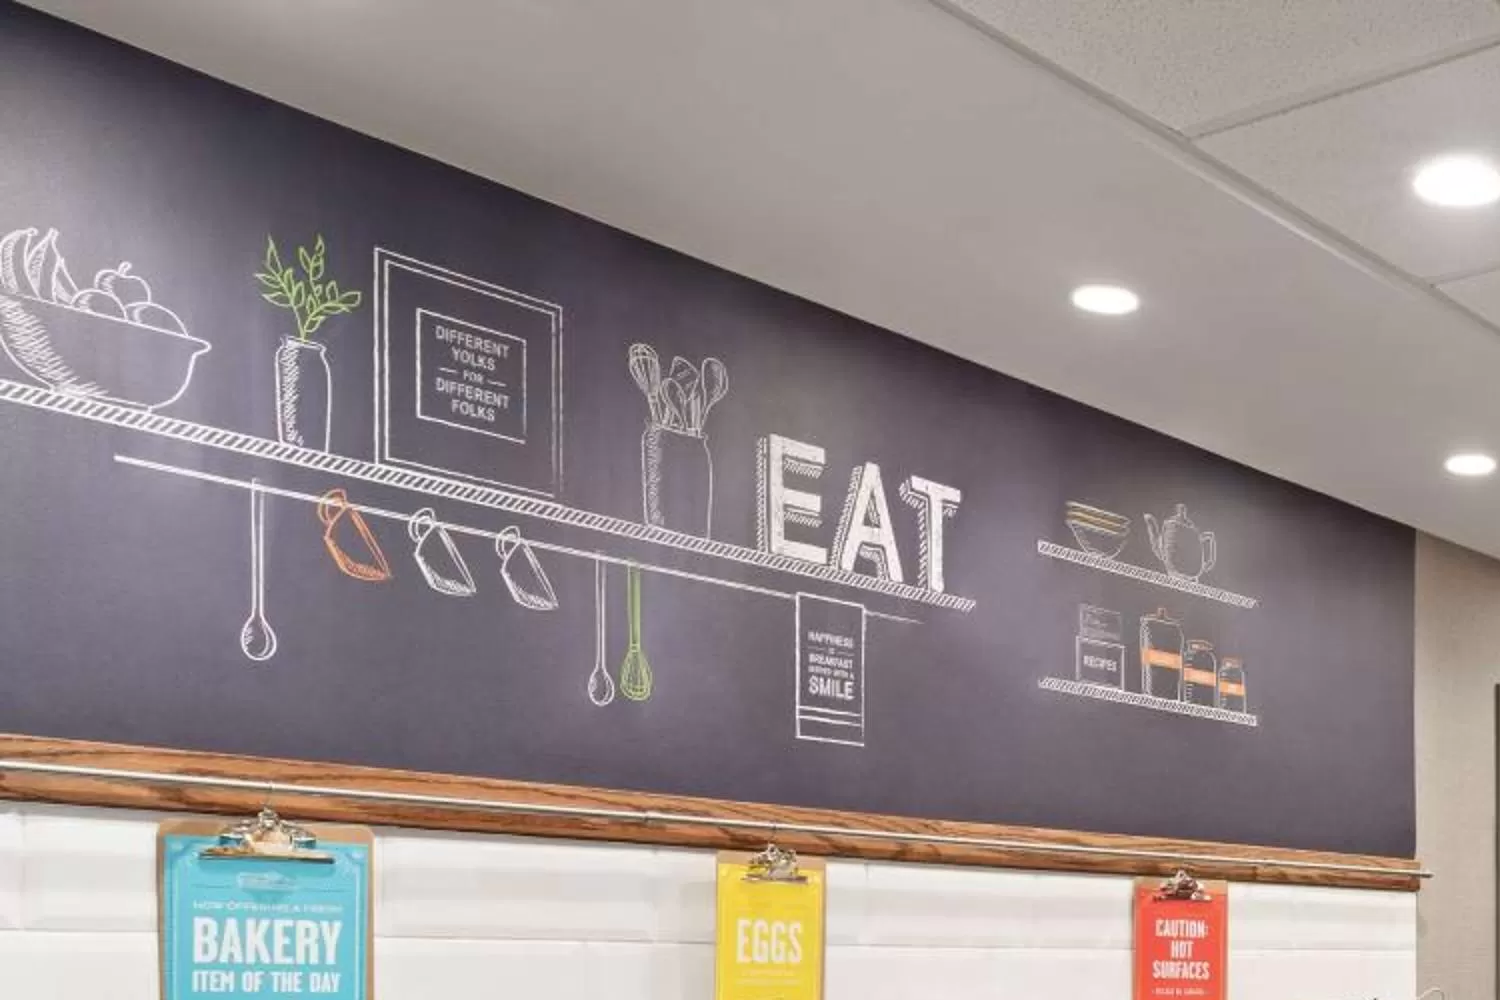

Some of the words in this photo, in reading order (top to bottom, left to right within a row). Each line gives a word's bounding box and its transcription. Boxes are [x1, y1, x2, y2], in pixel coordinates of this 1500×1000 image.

[435, 325, 509, 359] DIFFERENT
[452, 346, 495, 371] YOLKS
[463, 369, 485, 384] FOR
[435, 377, 509, 409] DIFFERENT
[452, 398, 495, 422] FOLKS
[757, 433, 961, 593] EAT
[808, 676, 855, 700] SMILE
[192, 916, 343, 965] BAKERY
[736, 918, 804, 964] EGGS
[1171, 941, 1194, 959] HOT
[191, 970, 235, 993] ITEM
[241, 971, 265, 993] OF
[271, 971, 303, 993] THE
[309, 971, 342, 993] DAY
[1152, 960, 1210, 980] SURFACES
